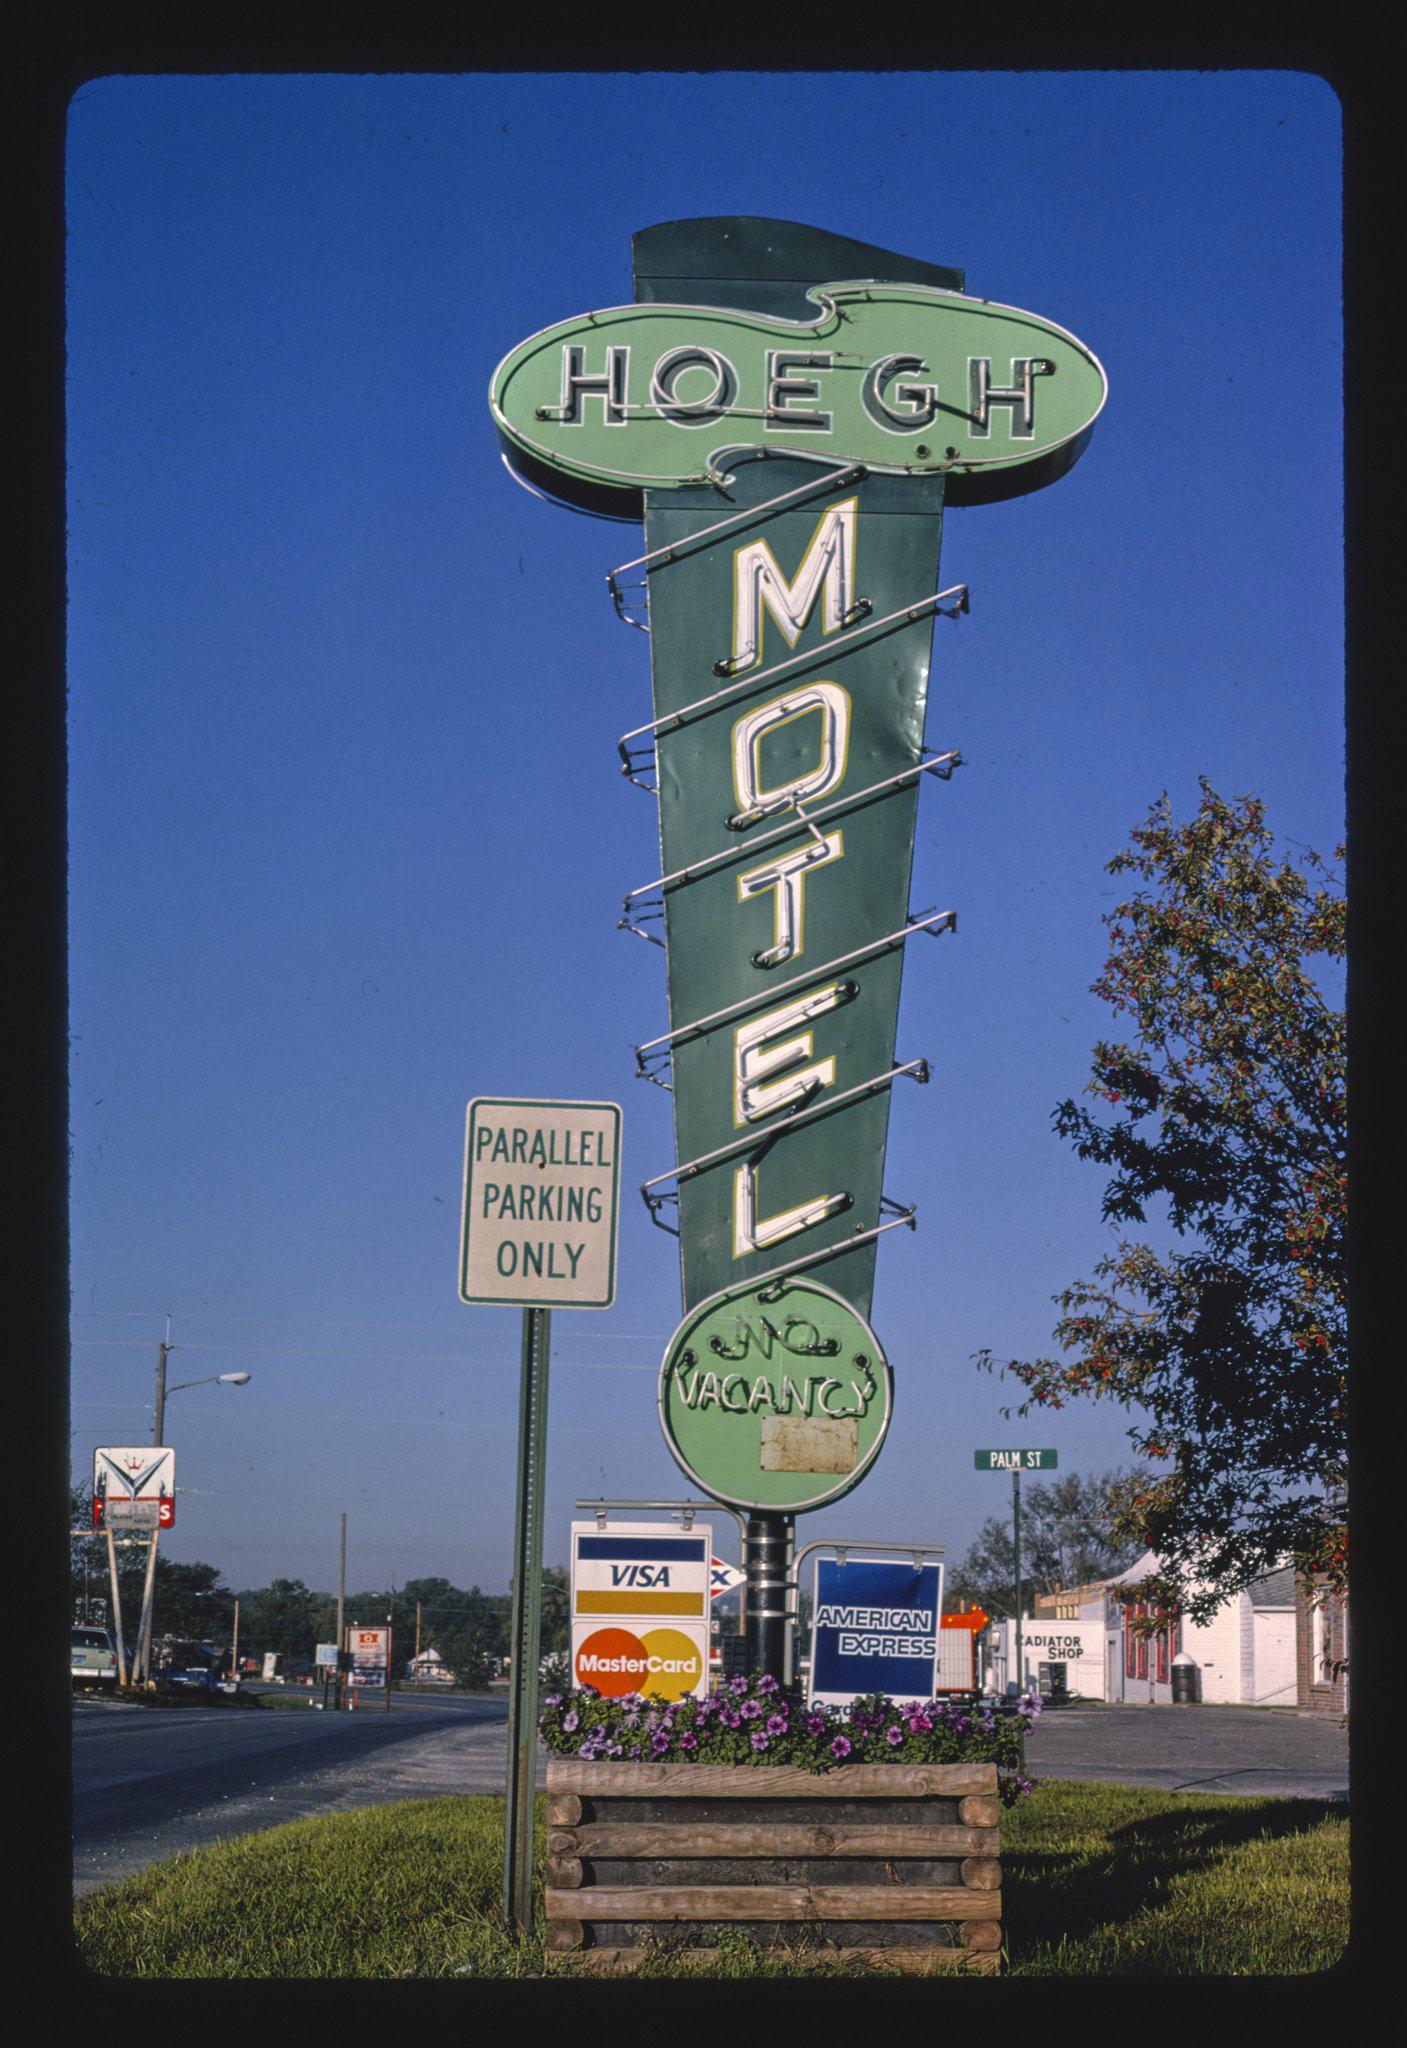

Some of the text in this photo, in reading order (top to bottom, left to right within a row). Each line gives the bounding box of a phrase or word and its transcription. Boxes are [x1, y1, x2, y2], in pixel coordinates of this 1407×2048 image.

[560, 343, 1035, 440] HOEGH
[731, 496, 858, 1260] MOTEL
[475, 1126, 611, 1167] PARALLEL
[483, 1183, 602, 1223] PARKING
[496, 1240, 585, 1279] ONLY
[736, 1314, 818, 1352] NO
[674, 1367, 873, 1415] VACANCY
[990, 1451, 1042, 1468] PALM ST
[610, 1565, 670, 1588] VISA
[816, 1605, 932, 1632] AMERICAN
[579, 1654, 697, 1674] MasterCard
[838, 1633, 937, 1659] EXPRESS
[1048, 1647, 1084, 1660] SHOP
